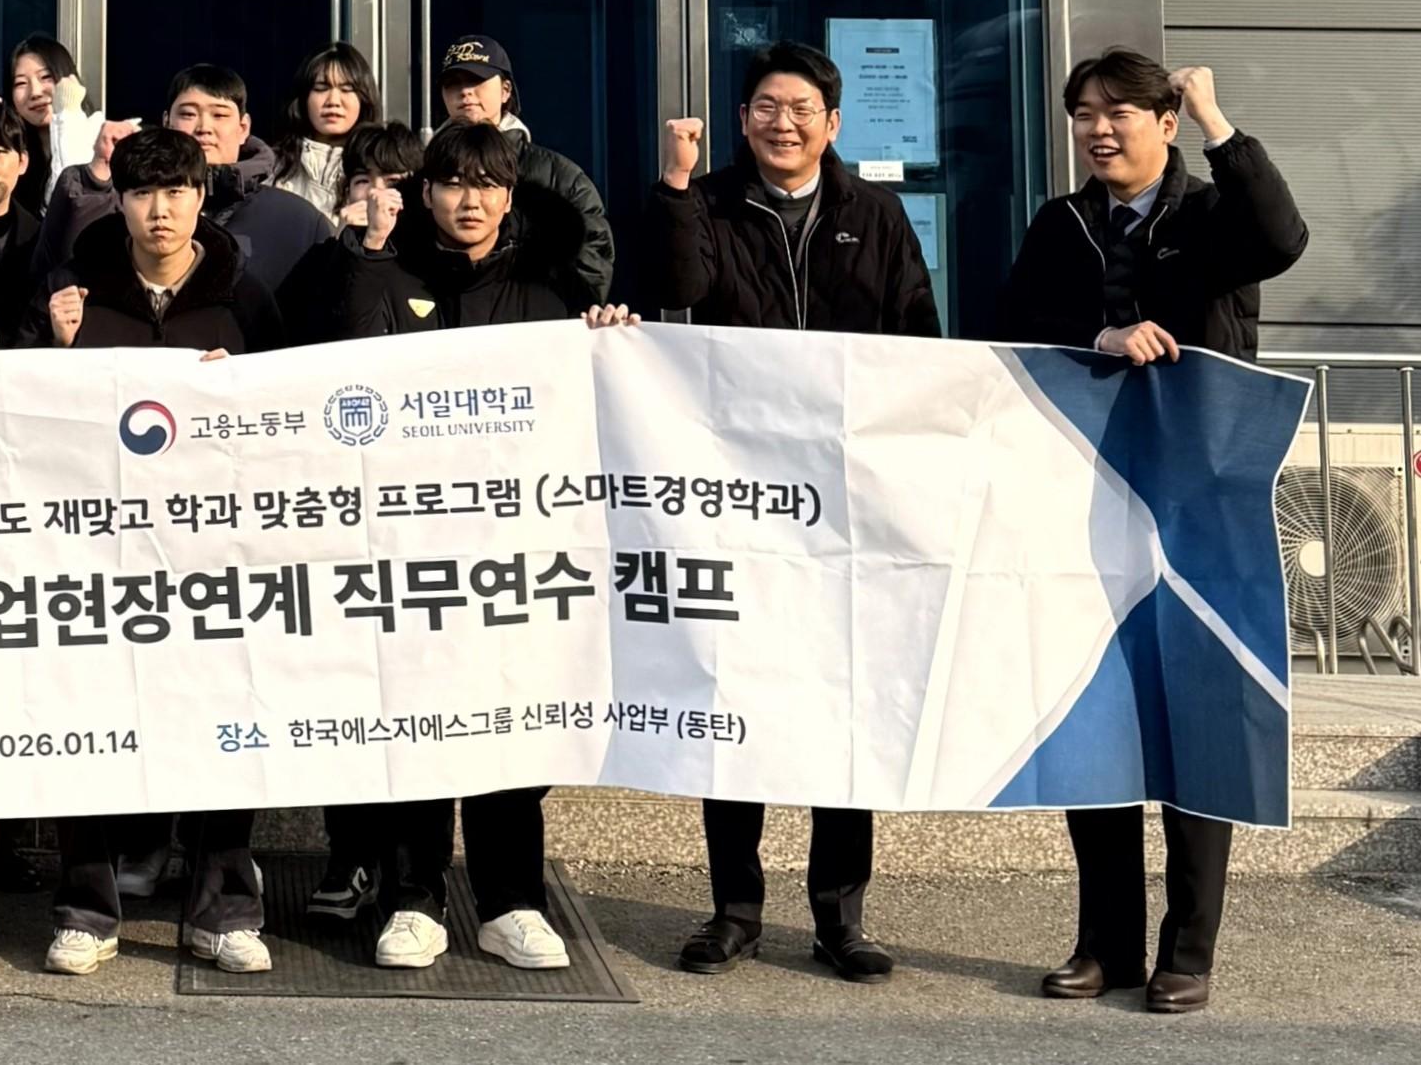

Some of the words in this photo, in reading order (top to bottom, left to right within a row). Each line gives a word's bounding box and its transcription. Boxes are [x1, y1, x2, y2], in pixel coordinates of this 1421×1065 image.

[400, 387, 534, 419] 서일대학교
[191, 411, 306, 439] 고용노동부
[402, 425, 444, 438] SEOIL
[448, 420, 534, 435] UNIVERSITY
[44, 498, 154, 536] 재맞고
[166, 493, 242, 533] 학과
[254, 485, 361, 530] 맞춤형
[377, 478, 520, 517] 프로그램
[536, 474, 821, 527] (스마트경영학과)
[334, 552, 595, 633] 직무연수
[614, 551, 739, 624] 캠프
[217, 723, 270, 752] 장소
[288, 707, 513, 747] 한국에스지에스그룹
[521, 701, 593, 730] 신뢰성
[604, 702, 668, 734] 사업부
[677, 711, 746, 744] (동탄)
